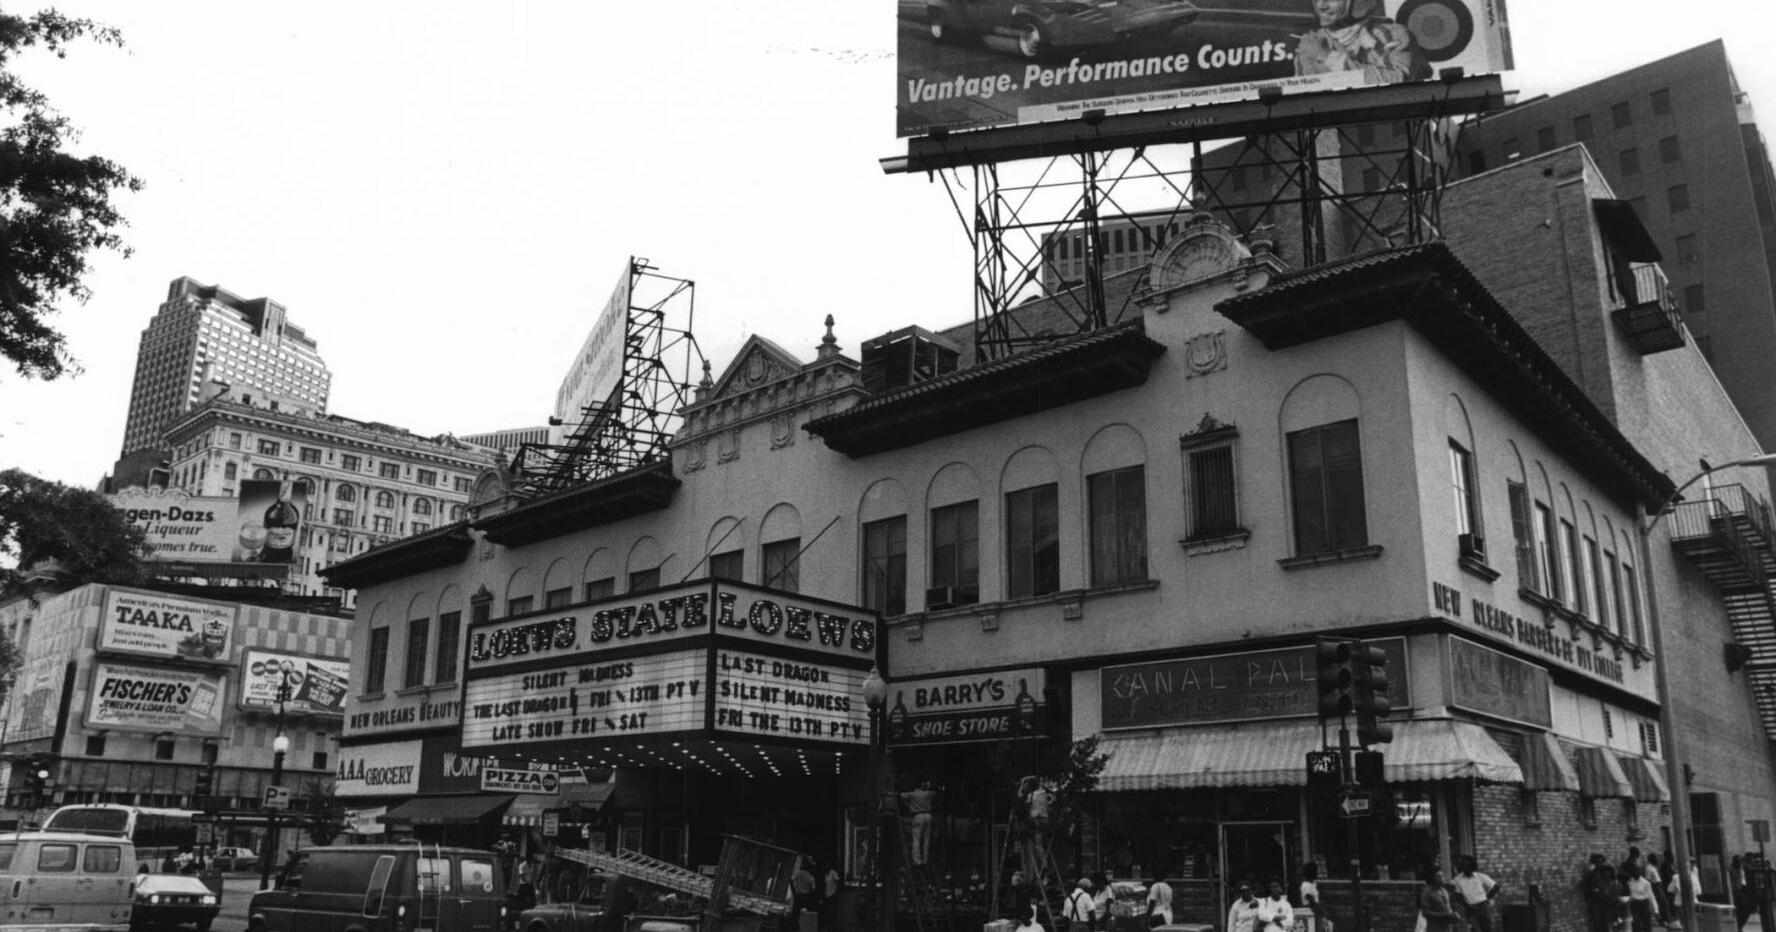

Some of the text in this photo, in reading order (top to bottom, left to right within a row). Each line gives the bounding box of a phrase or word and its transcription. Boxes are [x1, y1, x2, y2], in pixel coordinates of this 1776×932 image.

[908, 39, 1294, 103] Vantage. Performance Counts.
[126, 506, 214, 524] gen-Dazs
[145, 521, 203, 538] Liqueur
[188, 542, 218, 553] true.
[1433, 581, 1461, 617] NEW
[116, 605, 194, 632] TAAKA
[471, 593, 708, 661] LOEWS STATE
[718, 592, 874, 652] LOEWS
[522, 662, 634, 690] SILENT MADNESS
[721, 653, 829, 683] LAST DRAGON
[1113, 656, 1317, 698] CANAL PAL
[100, 678, 191, 704] FISCHER'S
[474, 704, 492, 719] THE
[494, 701, 521, 717] LAST
[523, 696, 567, 714] DRAGON
[590, 690, 611, 707] FRI
[630, 685, 660, 703] 13TH
[721, 680, 850, 712] SILENT MADNESS
[915, 678, 1005, 708] BARRY'S
[351, 701, 461, 729] NEW ORLEANS BEAUTY
[493, 724, 522, 741] LATE
[527, 720, 564, 738] SHOW
[572, 717, 596, 734] FRI
[620, 712, 648, 731] SAT
[718, 708, 862, 739] FRI THE 13TH PT V
[912, 716, 1009, 738] SHOE STORE
[336, 758, 415, 786] AAA GROCERY
[486, 770, 541, 783] PIZZA
